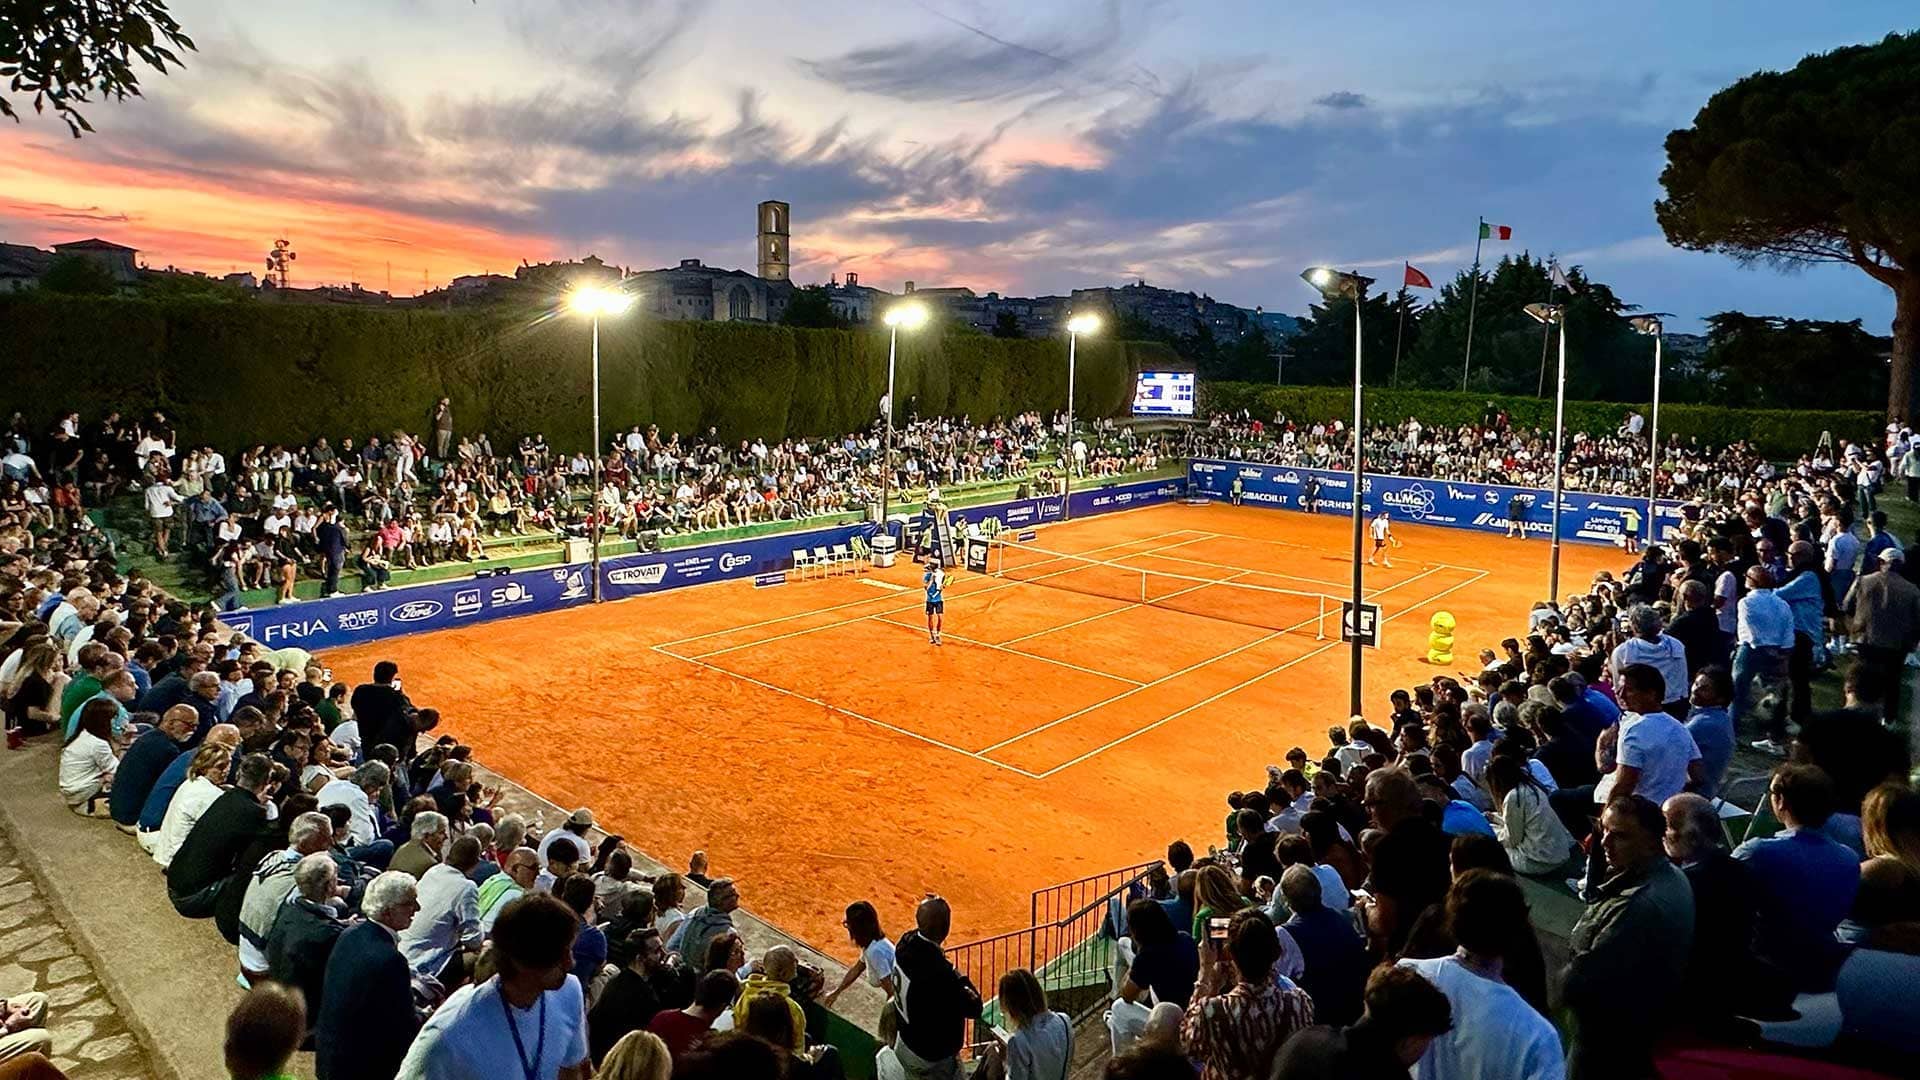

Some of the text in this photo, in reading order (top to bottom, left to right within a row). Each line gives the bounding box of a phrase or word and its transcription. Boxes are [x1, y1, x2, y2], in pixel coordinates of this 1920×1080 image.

[1584, 520, 1620, 534] Energy
[1590, 516, 1621, 526] Umbria
[622, 566, 660, 580] TROVATI
[338, 608, 379, 622] SATIRI
[400, 603, 434, 619] Ford
[338, 615, 379, 630] AUTO
[264, 618, 330, 643] FRIA
